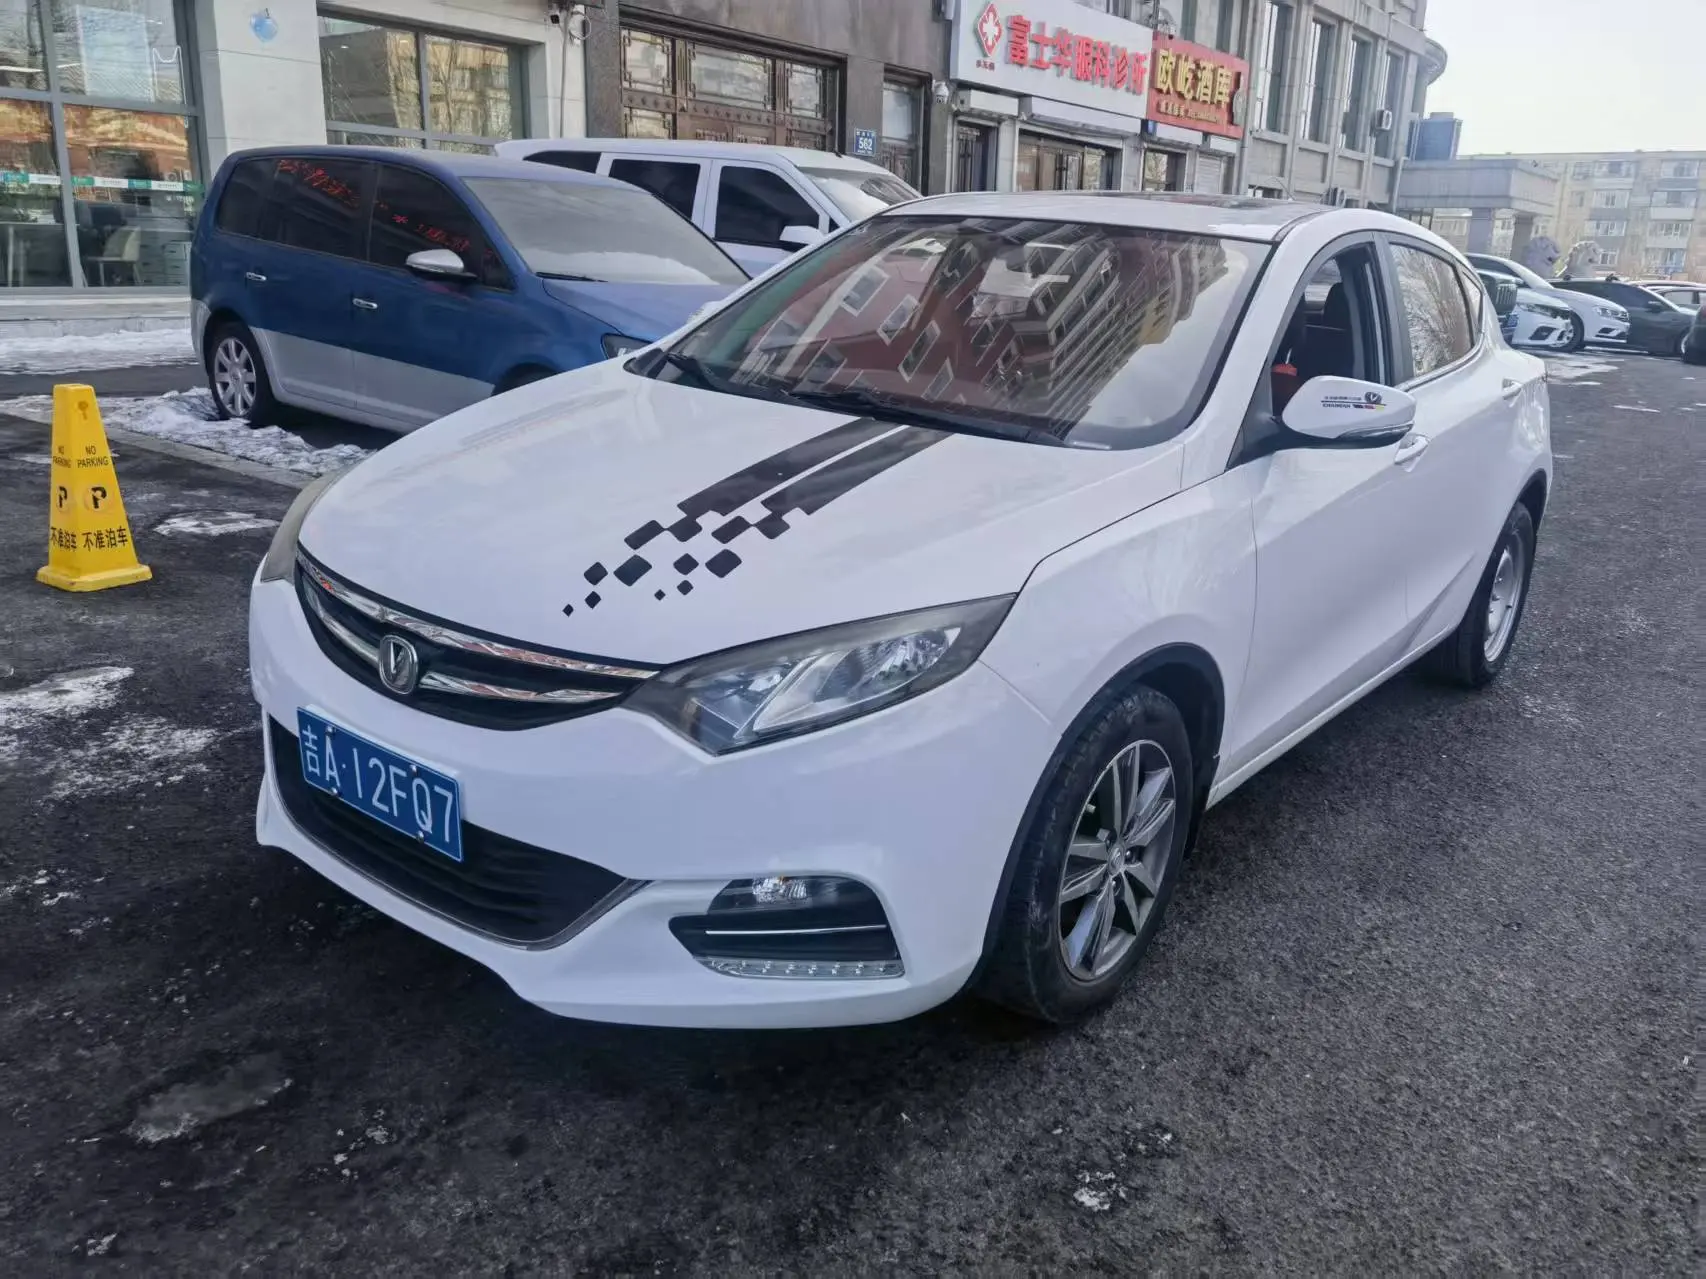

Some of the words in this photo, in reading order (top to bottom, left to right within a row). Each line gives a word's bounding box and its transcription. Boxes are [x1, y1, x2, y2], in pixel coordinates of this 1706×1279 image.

[1007, 15, 1147, 95] 富士华眼科诊所
[858, 137, 872, 150] 562
[85, 445, 97, 455] NO
[77, 456, 109, 468] PARKING
[91, 486, 107, 509] P
[82, 525, 128, 552] 不准泊车
